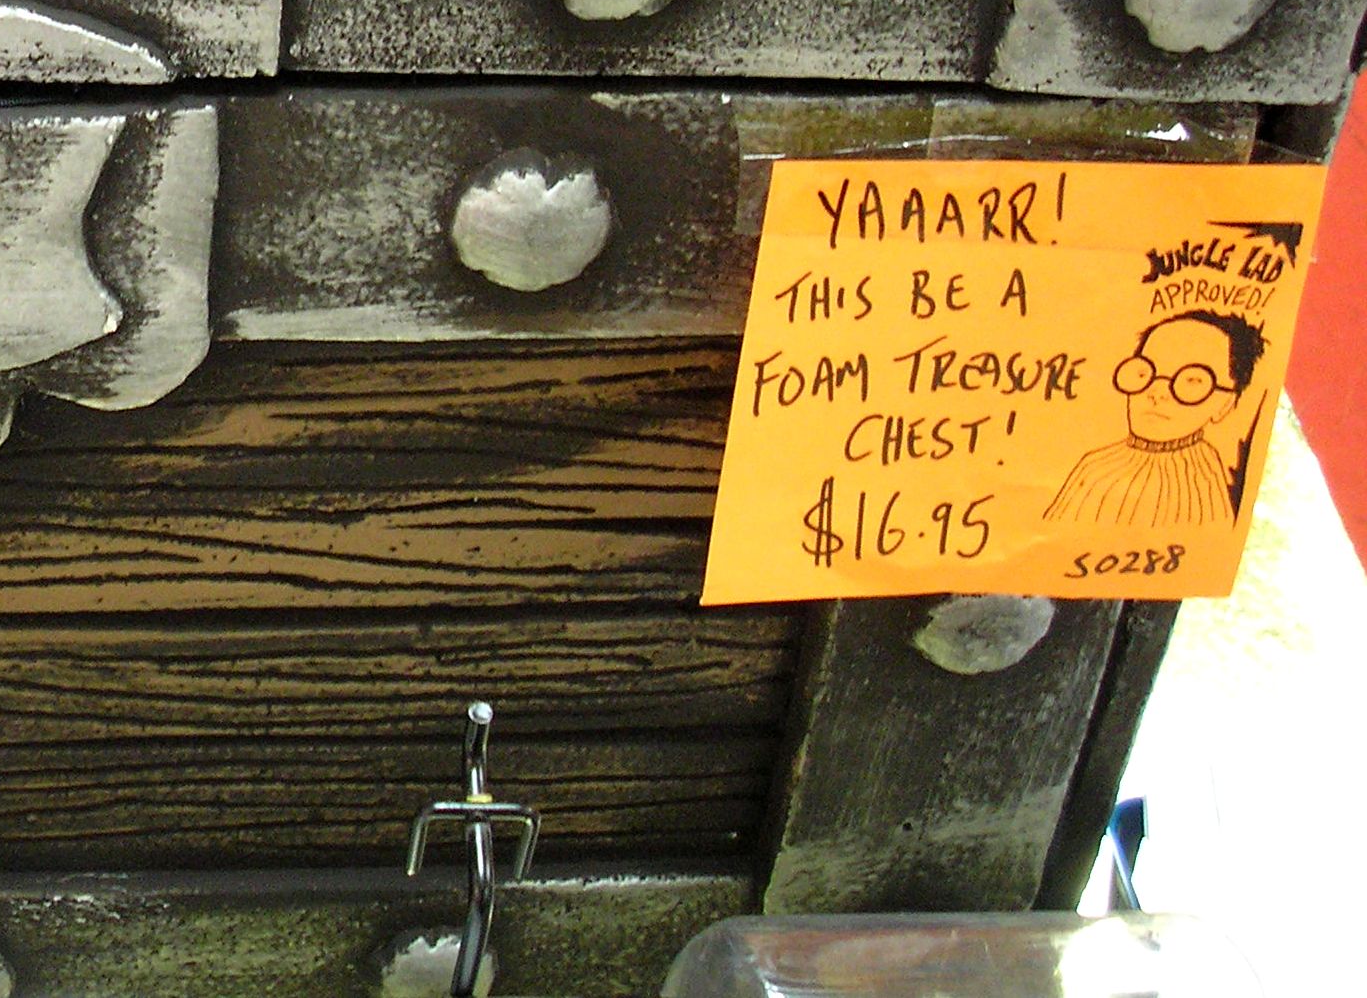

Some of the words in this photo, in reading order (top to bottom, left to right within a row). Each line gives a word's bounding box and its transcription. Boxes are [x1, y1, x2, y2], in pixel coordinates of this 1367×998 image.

[818, 173, 1067, 248] YAAARR!
[1238, 246, 1284, 284] LAD
[776, 271, 873, 323] THIS
[910, 269, 969, 319] BE
[1001, 269, 1028, 316] A
[1150, 278, 1275, 315] APPROVED!
[753, 352, 868, 416] FOAM
[893, 336, 1086, 401] TREASURE
[844, 410, 1017, 466] CHEST!
[802, 477, 994, 567] $16.95
